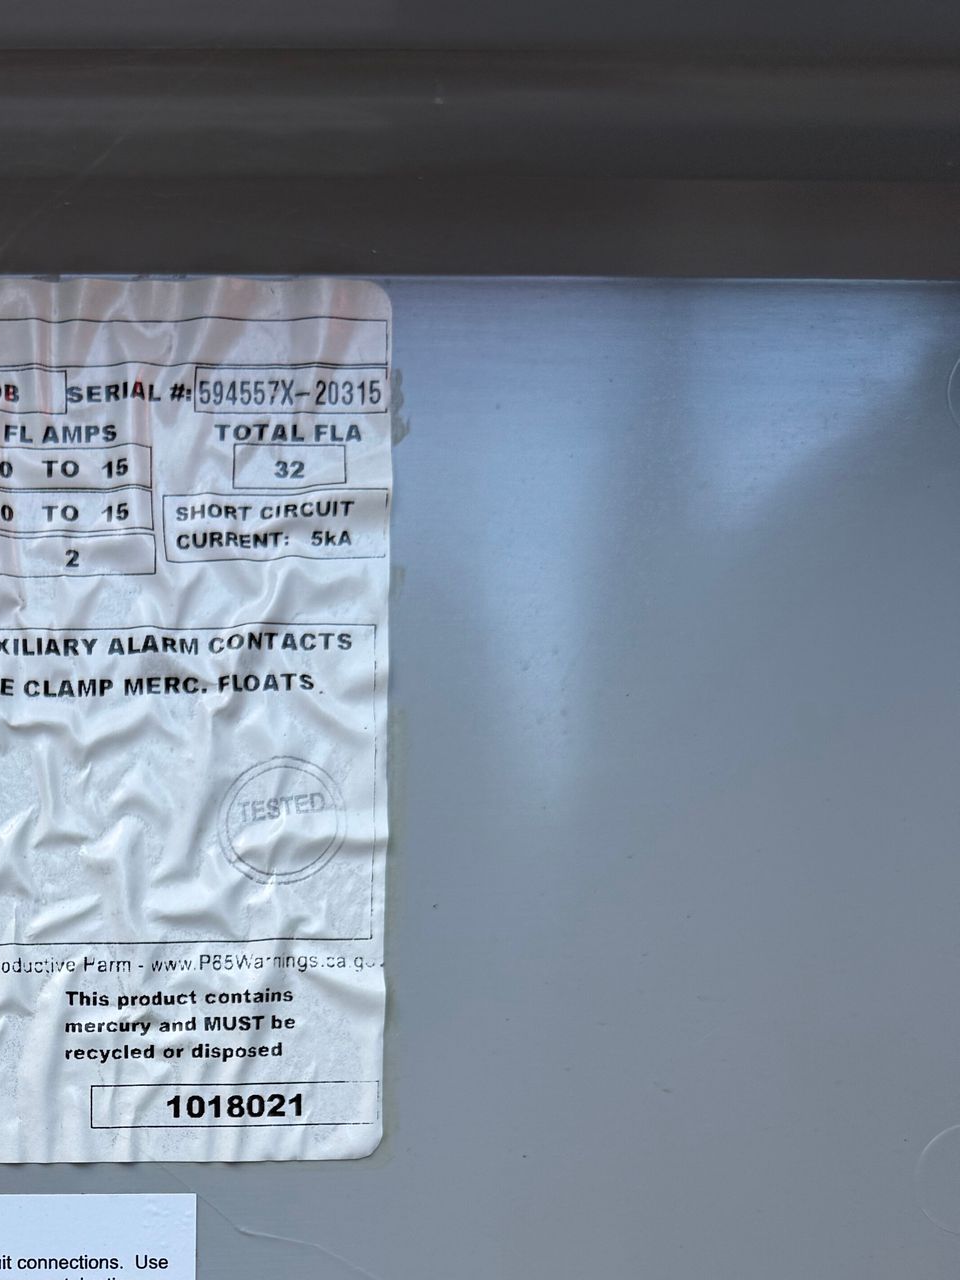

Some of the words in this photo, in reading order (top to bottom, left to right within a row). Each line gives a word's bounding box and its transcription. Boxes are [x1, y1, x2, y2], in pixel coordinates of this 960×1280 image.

[66, 380, 162, 404] SERIAL
[198, 378, 382, 406] 594557X-20315
[3, 423, 34, 444] FL
[41, 423, 118, 444] AMPS
[214, 423, 305, 443] TOTAL
[314, 423, 362, 443] FLA
[41, 460, 80, 479] TO
[102, 457, 129, 479] 15
[274, 459, 305, 479] 32
[65, 549, 80, 568] 2
[108, 634, 199, 656] ALARM
[208, 630, 352, 654] CONTACTS
[239, 791, 325, 822] TESTED
[65, 990, 110, 1007] This
[117, 990, 197, 1010] product
[204, 987, 294, 1005] contains
[64, 1015, 152, 1037] mercury
[158, 1016, 197, 1033] and
[204, 1015, 266, 1032] MUST
[270, 1014, 296, 1030] be
[65, 1044, 155, 1064] recycled
[162, 1047, 185, 1059] or
[191, 1041, 283, 1063] disposed
[166, 1093, 302, 1119] 1018021
[17, 1254, 124, 1270] connections.
[135, 1254, 169, 1270] Use
